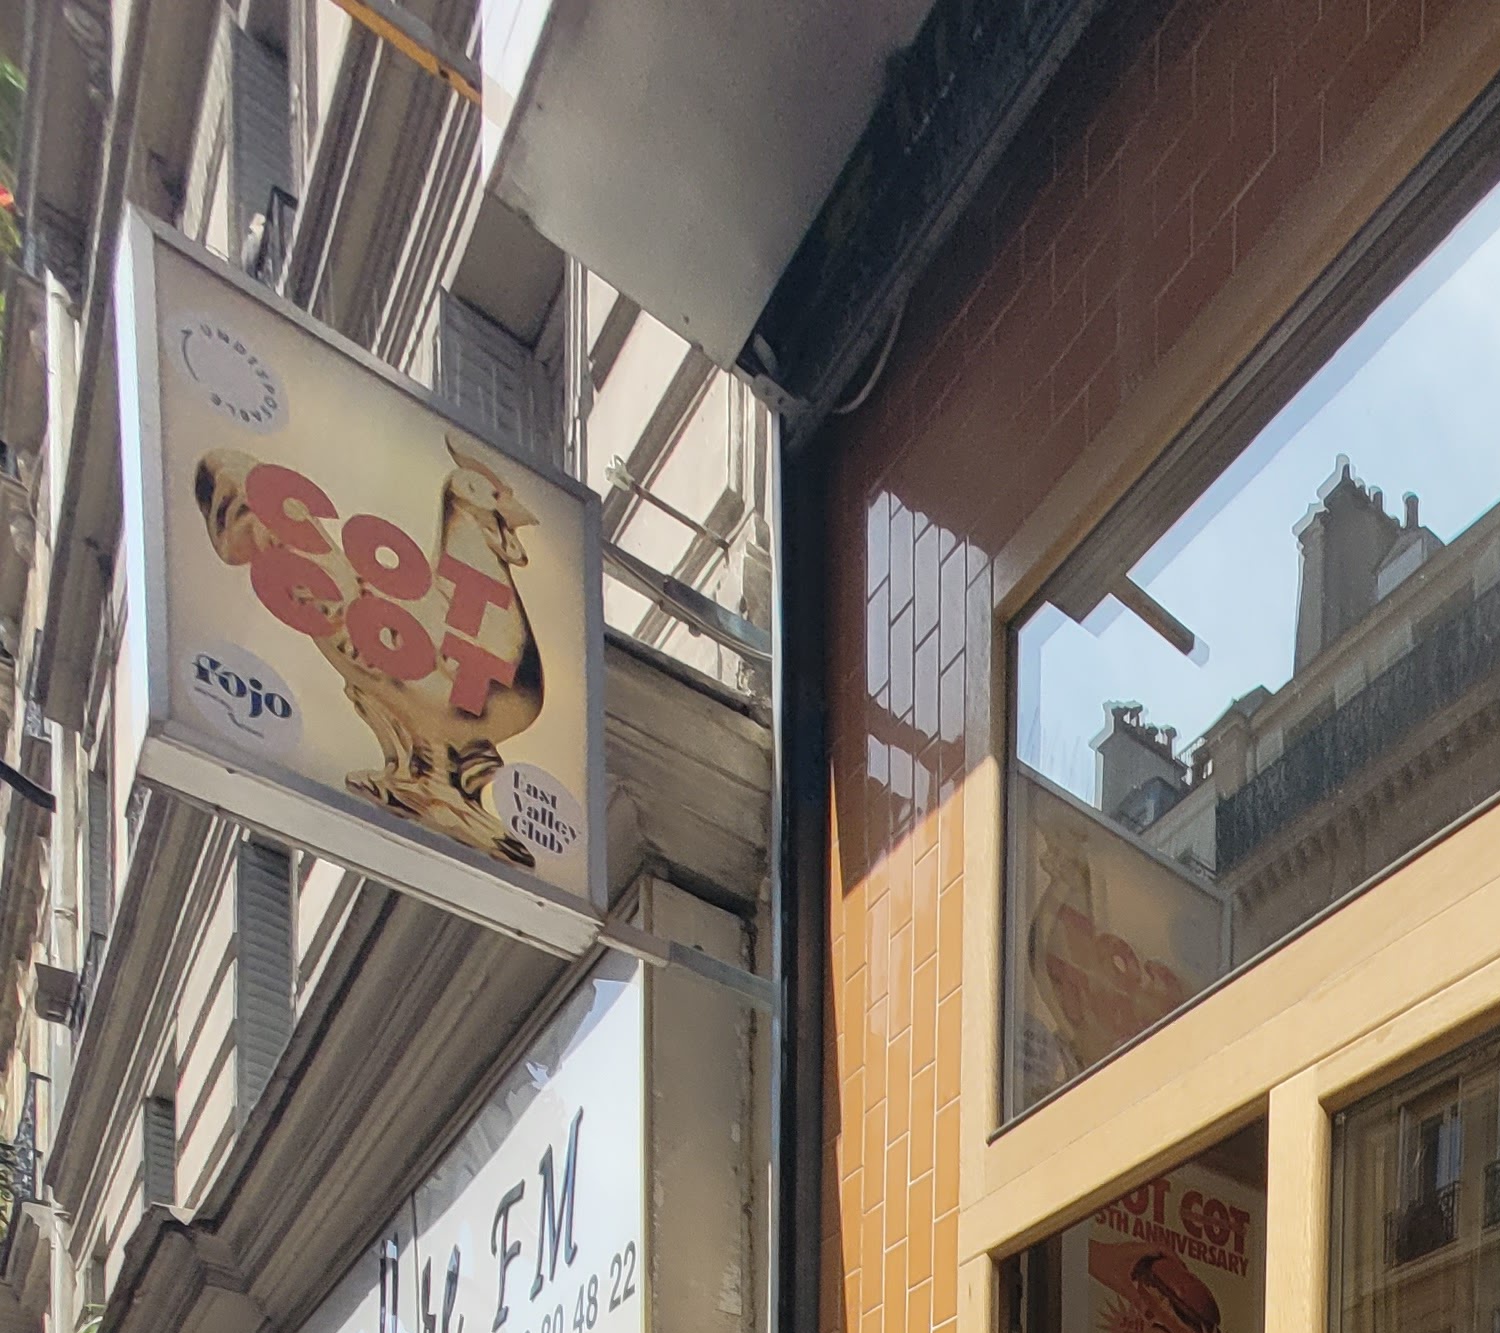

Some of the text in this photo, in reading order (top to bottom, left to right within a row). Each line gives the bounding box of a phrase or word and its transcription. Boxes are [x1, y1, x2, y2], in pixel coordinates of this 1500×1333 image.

[245, 463, 513, 638] COT
[250, 550, 516, 717] COT
[511, 815, 563, 854] Club
[513, 791, 577, 845] Valley
[1110, 1179, 1250, 1254] OT COT
[1132, 1217, 1248, 1278] ANNIVERSARY
[608, 1240, 637, 1314] 22
